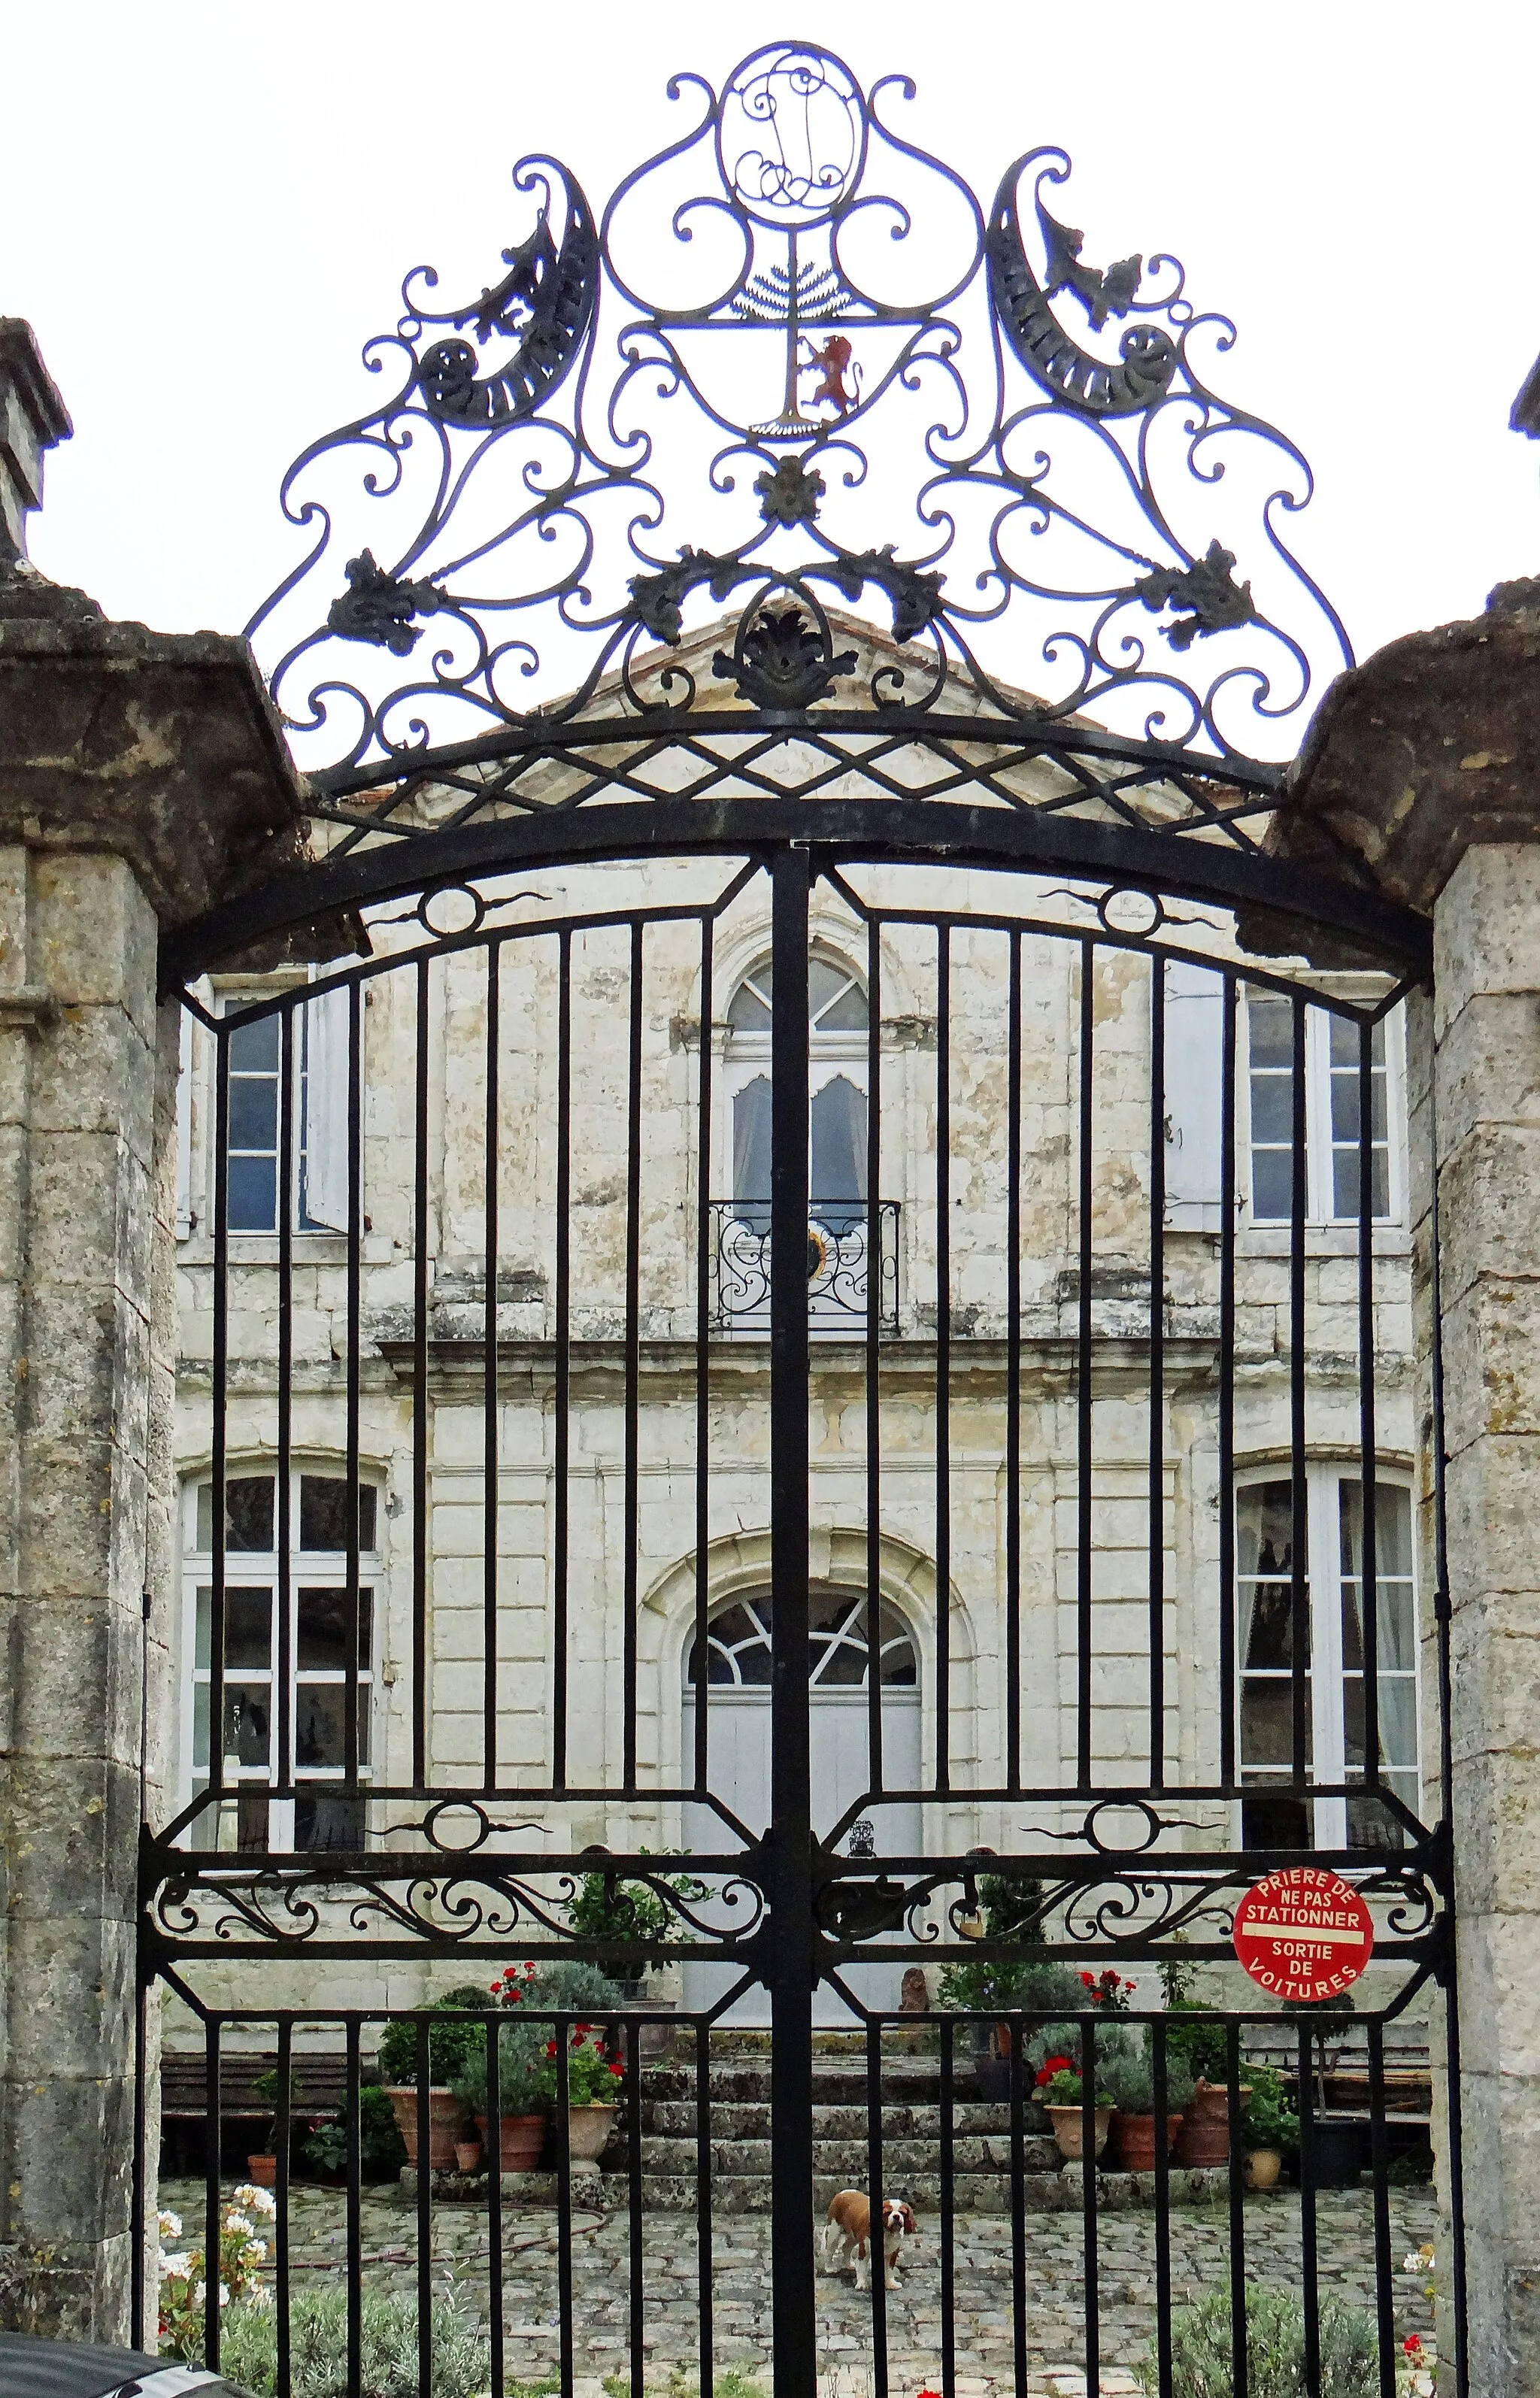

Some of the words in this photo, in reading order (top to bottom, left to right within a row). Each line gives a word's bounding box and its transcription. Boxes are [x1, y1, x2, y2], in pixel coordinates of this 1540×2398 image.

[1257, 1869, 1329, 1898] PRIERE
[1331, 1879, 1357, 1904] DE
[1281, 1890, 1300, 1905] NE
[1304, 1891, 1332, 1907] PAS
[1247, 1905, 1360, 1928] STATIONNER
[1272, 1942, 1332, 1960] SORTIE
[1249, 1957, 1357, 1998] VOITURES
[1290, 1960, 1312, 1976] DE
